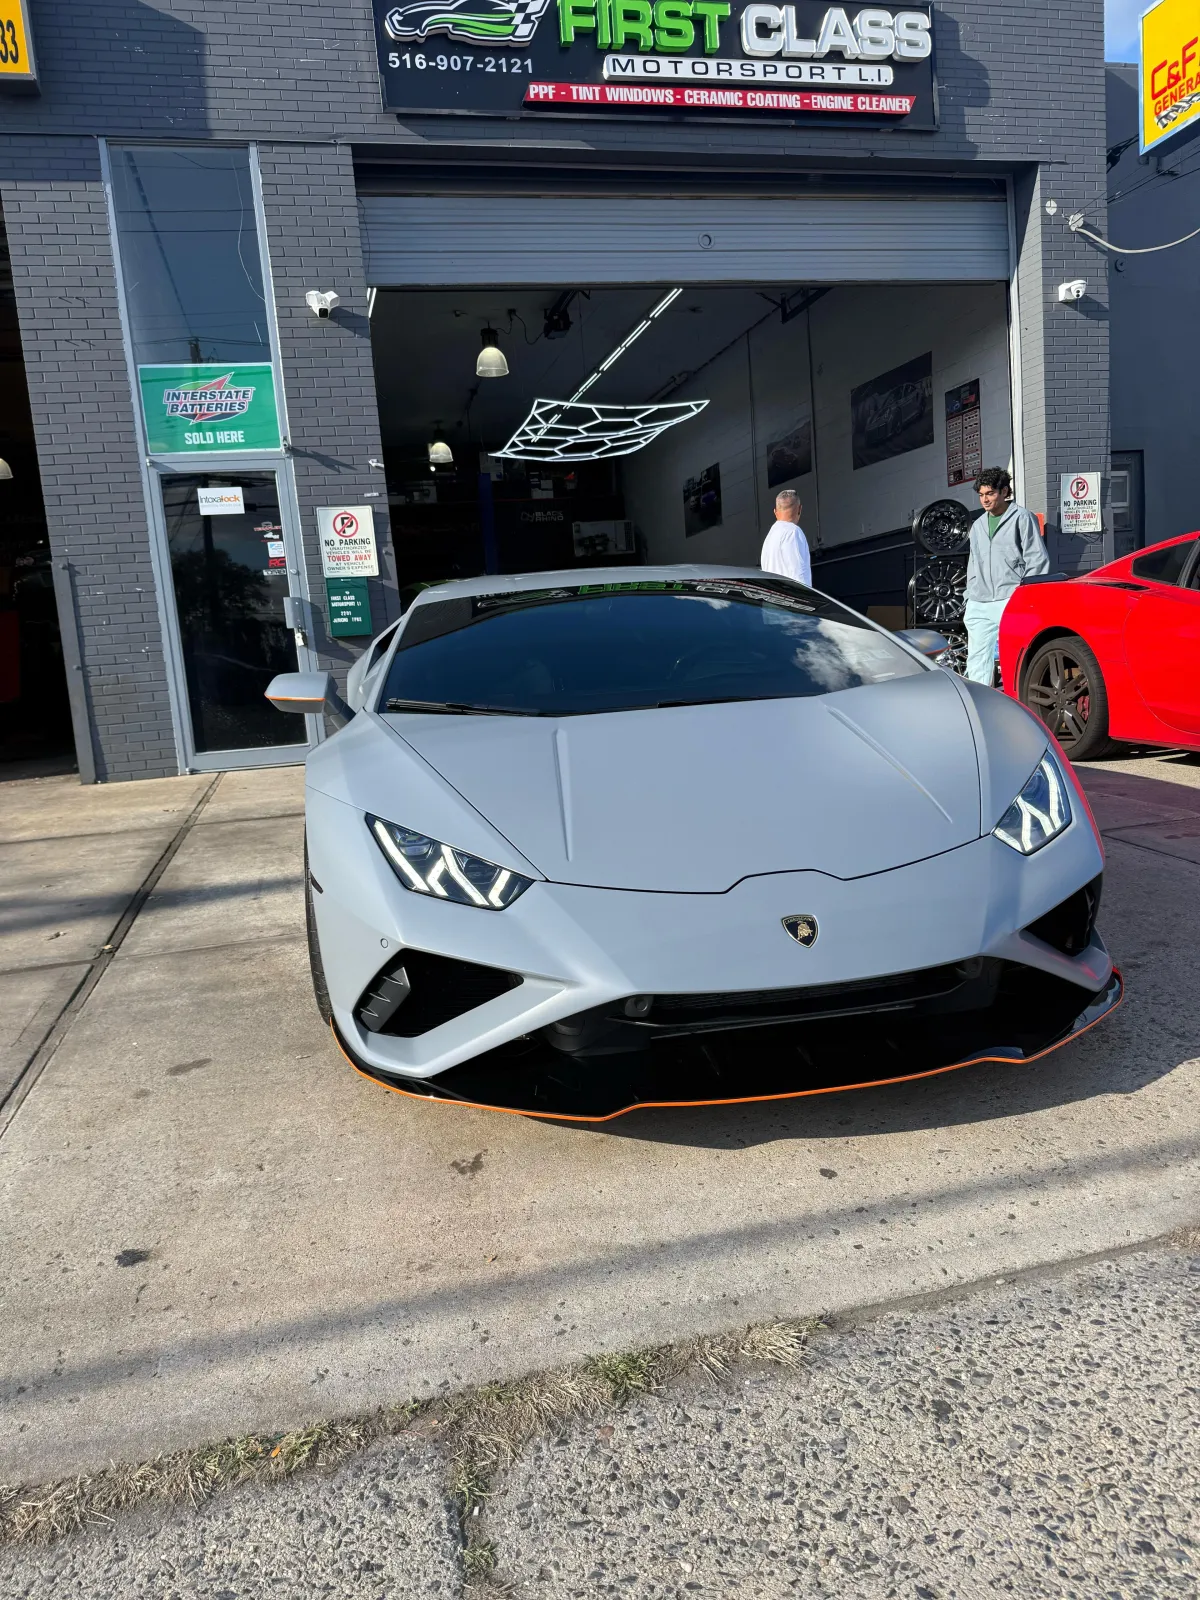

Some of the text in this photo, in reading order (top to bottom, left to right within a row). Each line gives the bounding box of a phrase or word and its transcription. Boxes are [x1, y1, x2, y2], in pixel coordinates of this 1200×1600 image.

[557, 0, 932, 62] FIRST CLASS
[388, 52, 533, 74] 516-907-2121
[612, 58, 888, 82] MOTORSPORT L.I.
[1151, 36, 1198, 100] C&F
[529, 84, 556, 99] PPF
[570, 85, 601, 101] TINT
[605, 87, 674, 104] WINDOWS
[684, 89, 742, 106] CERAMIC
[746, 92, 801, 109] COATING
[811, 95, 854, 110] ENGINE
[857, 97, 911, 112] CLEANER
[166, 389, 251, 401] INTERSTATE
[170, 401, 246, 413] BATTERIES
[184, 431, 245, 445] SOLD HERE
[324, 538, 371, 547] NO PARKING
[327, 553, 372, 562] TOWED AWAY
